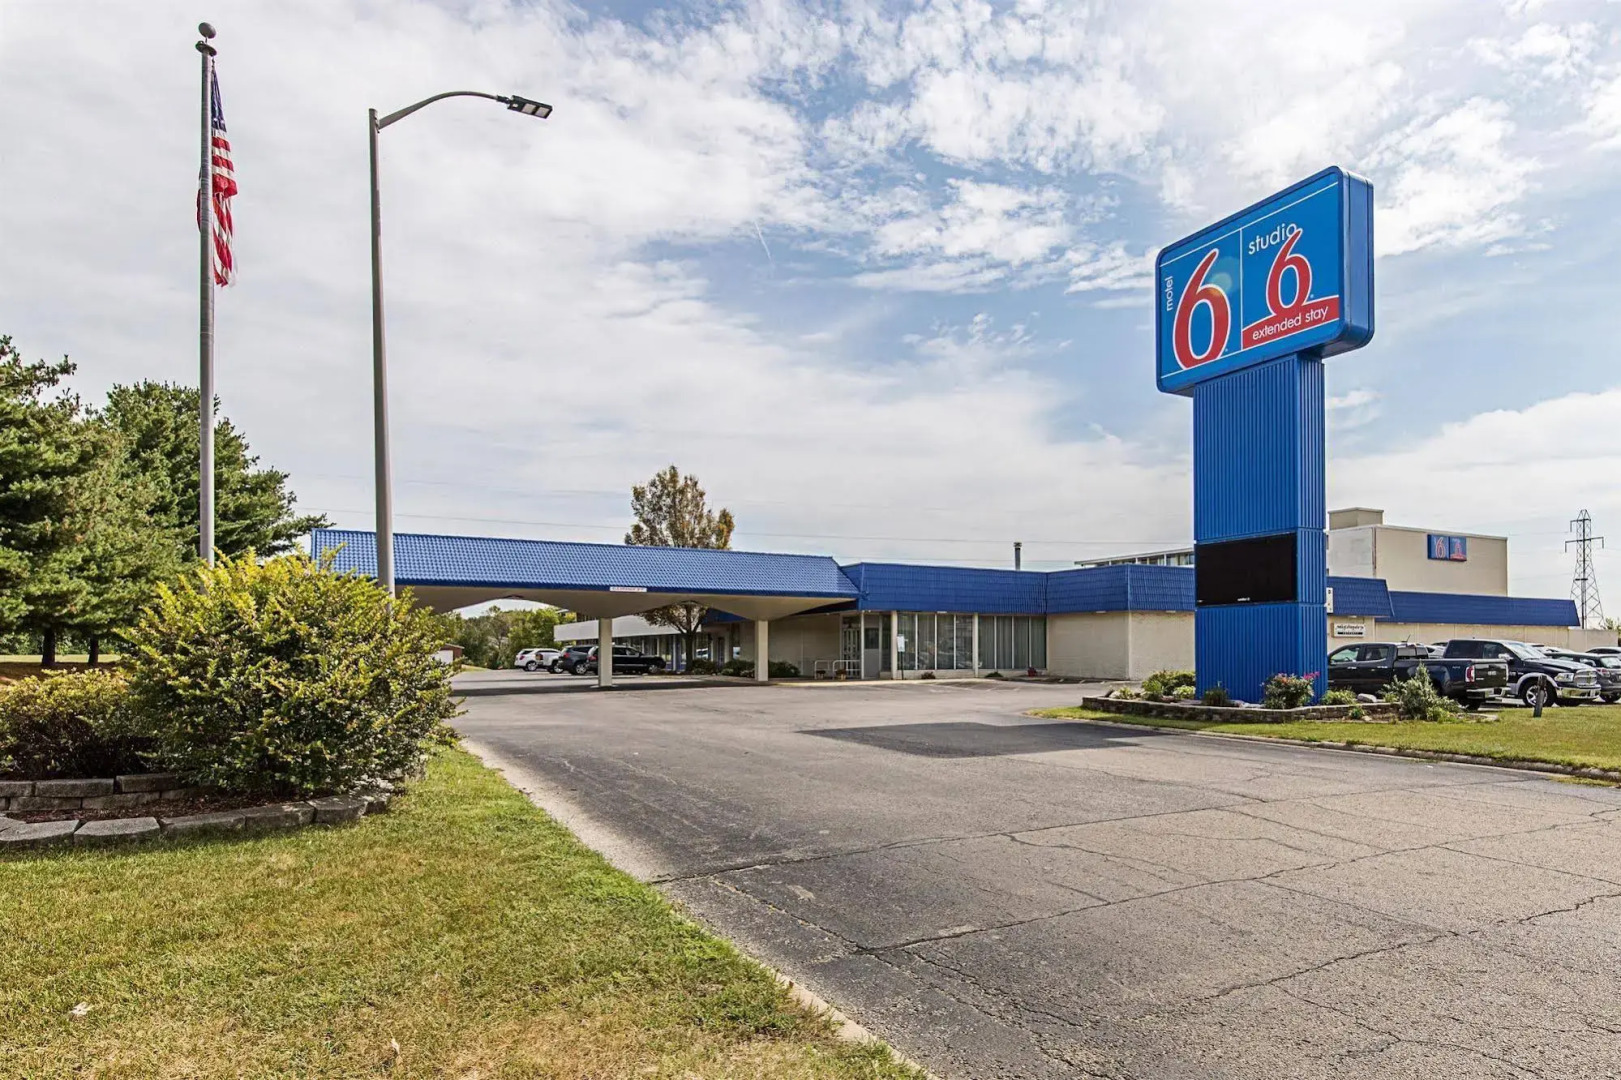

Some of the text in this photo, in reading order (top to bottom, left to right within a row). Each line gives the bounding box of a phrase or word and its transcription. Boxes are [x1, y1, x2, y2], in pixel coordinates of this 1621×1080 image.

[1248, 223, 1297, 255] studio
[1266, 227, 1313, 315] 6
[1164, 275, 1174, 312] motel
[1173, 248, 1231, 369] 6
[1252, 306, 1329, 340] extended stay
